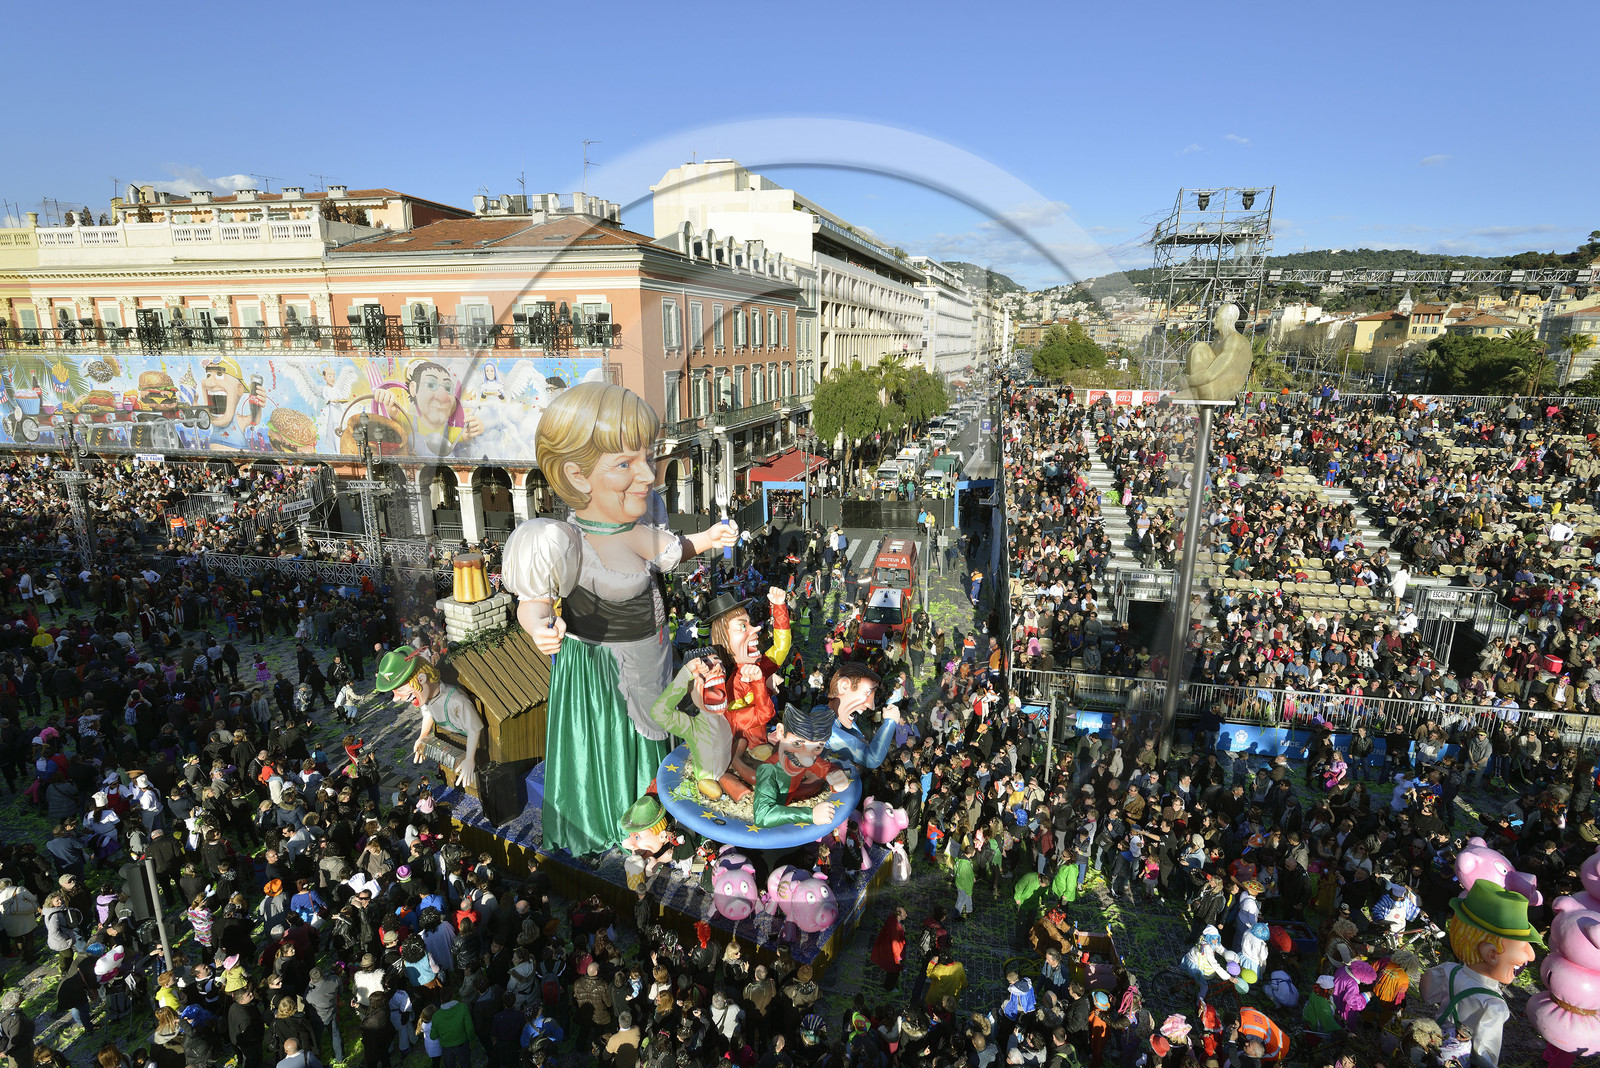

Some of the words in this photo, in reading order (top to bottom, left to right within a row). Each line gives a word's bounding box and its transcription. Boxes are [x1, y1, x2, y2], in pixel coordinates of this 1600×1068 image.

[1117, 394, 1131, 402] RTL2
[1143, 395, 1158, 403] RTL2
[900, 557, 907, 565] A
[1432, 591, 1452, 599] ESCALIER
